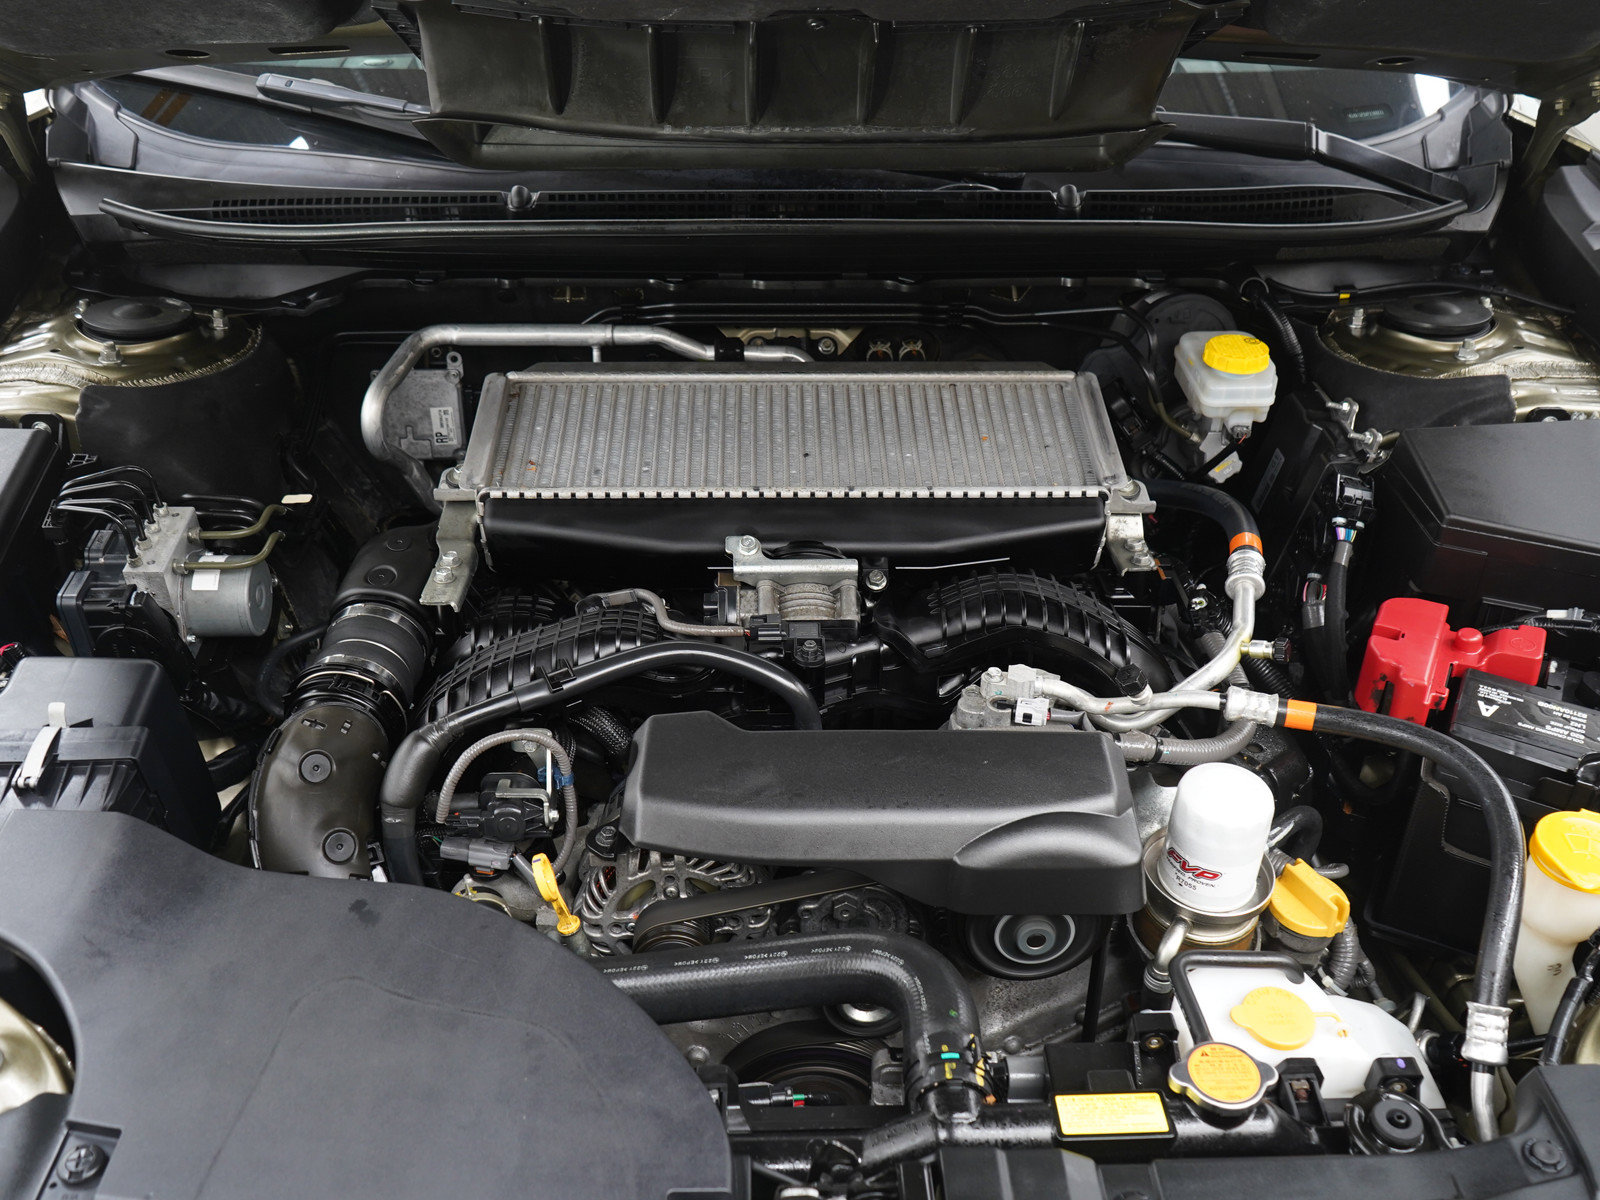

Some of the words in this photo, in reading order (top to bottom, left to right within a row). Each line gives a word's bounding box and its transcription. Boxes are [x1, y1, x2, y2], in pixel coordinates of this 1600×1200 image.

[435, 432, 448, 443] RP
[1517, 722, 1535, 730] AMPS
[1545, 725, 1570, 735] AMPS
[1535, 727, 1567, 739] CRANKING
[1567, 736, 1585, 744] COLD
[1167, 847, 1222, 881] FVP
